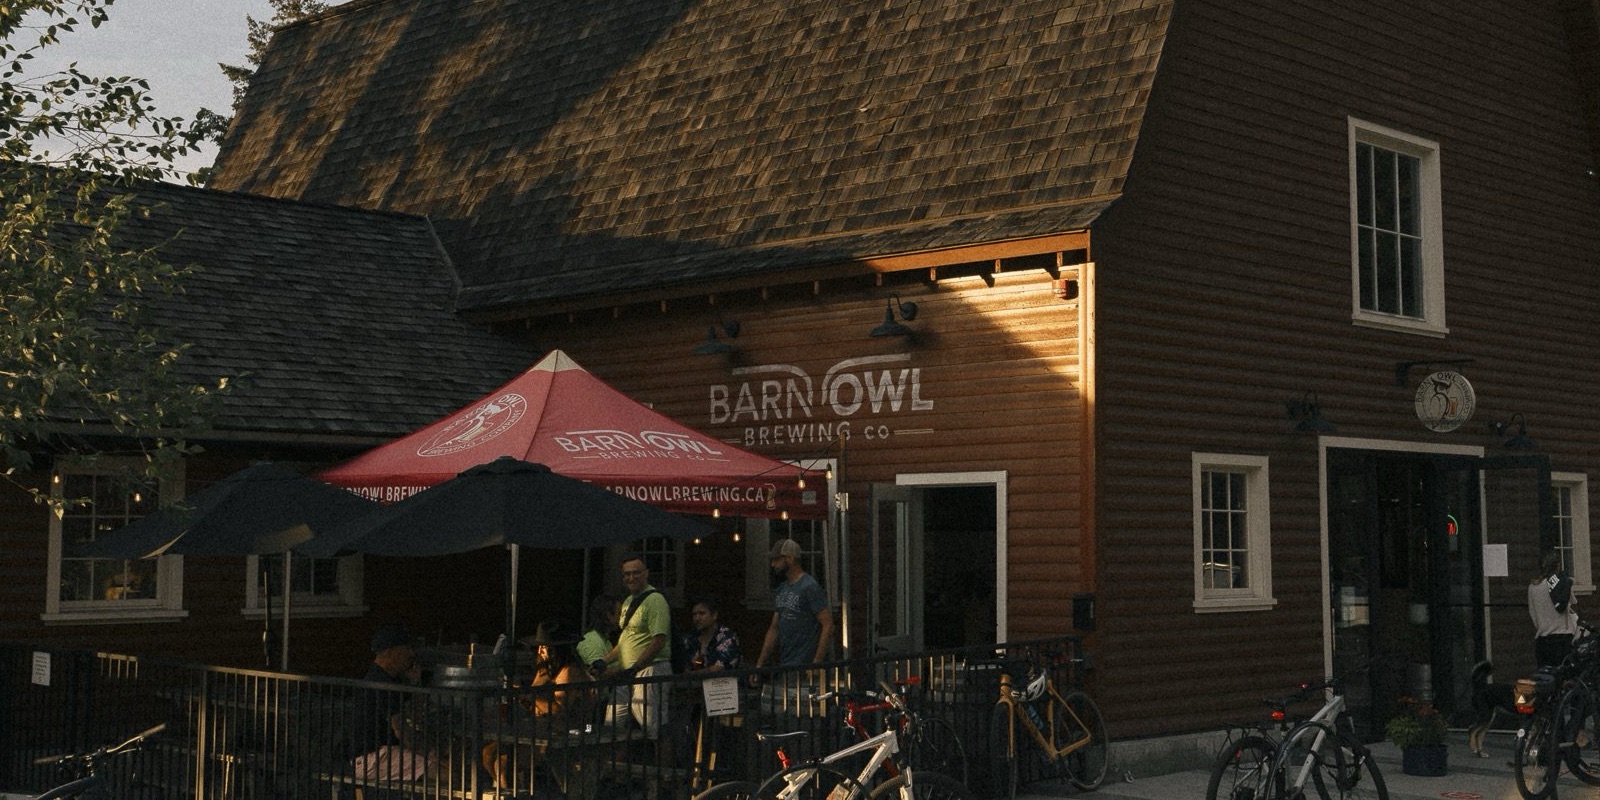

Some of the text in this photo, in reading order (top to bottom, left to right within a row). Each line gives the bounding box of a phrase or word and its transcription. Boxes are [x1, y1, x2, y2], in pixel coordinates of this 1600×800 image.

[1437, 372, 1456, 382] OWL
[498, 394, 523, 407] OWL
[709, 364, 934, 424] BARN OWL
[554, 429, 723, 455] BARN OWL
[745, 421, 889, 447] BREWING CO
[600, 450, 680, 460] BREWING
